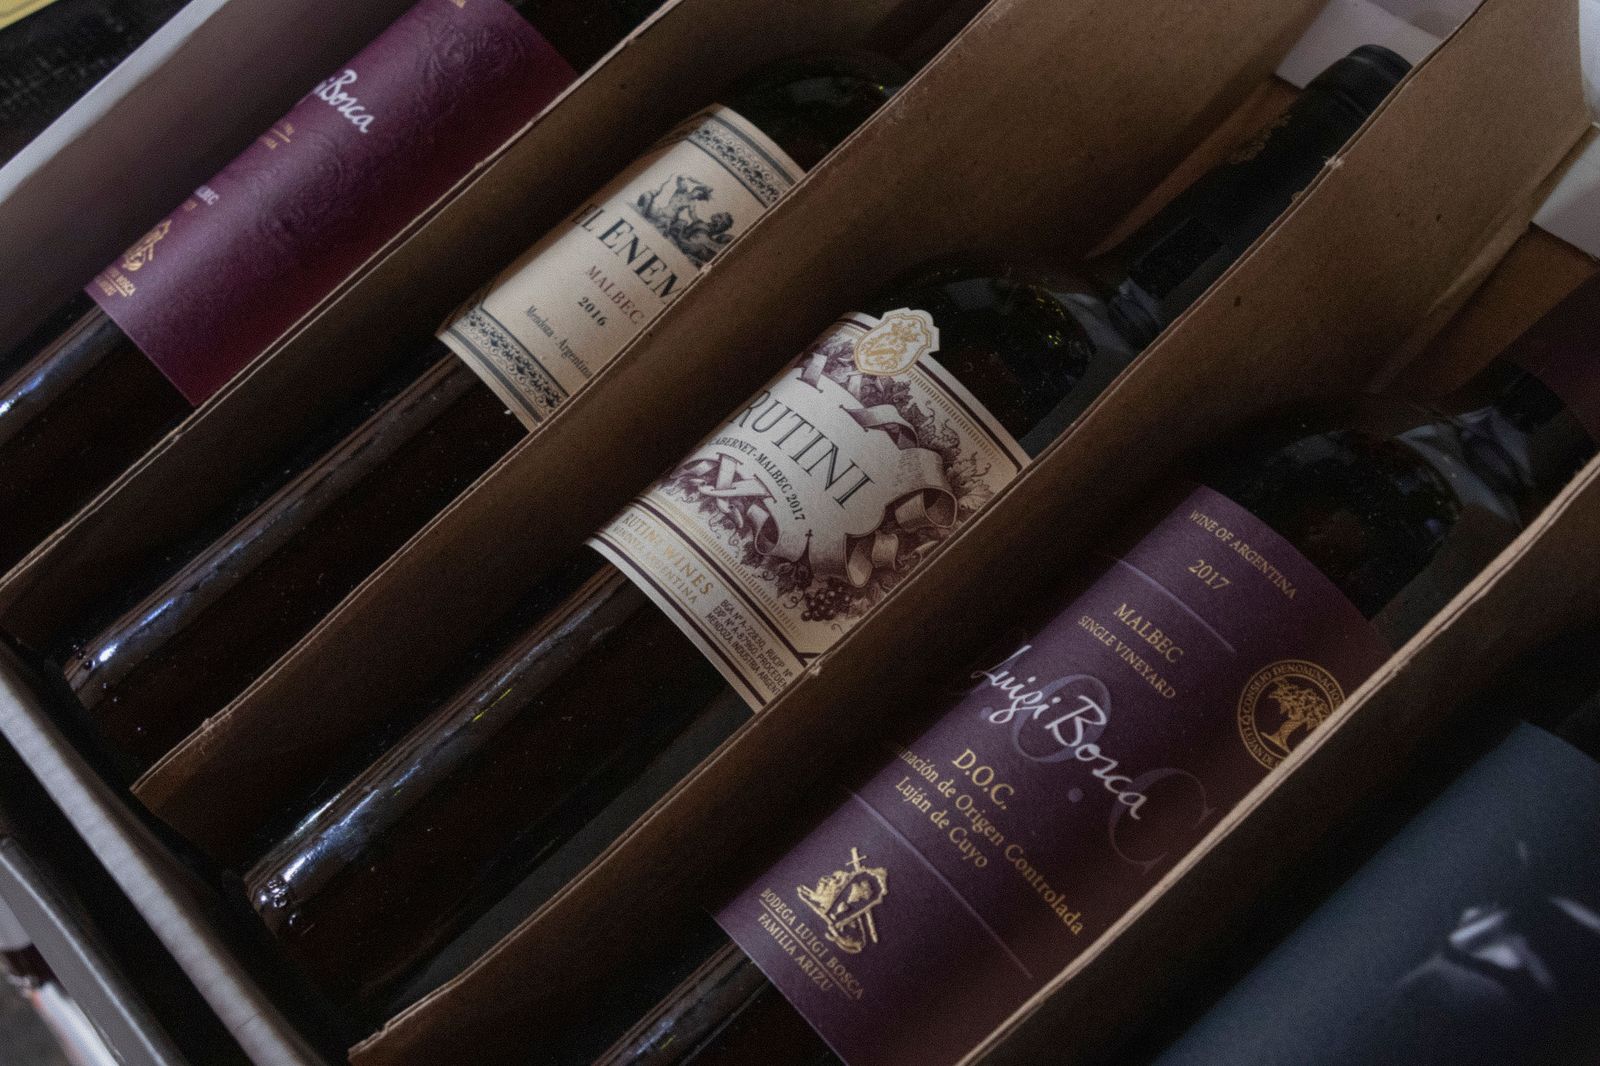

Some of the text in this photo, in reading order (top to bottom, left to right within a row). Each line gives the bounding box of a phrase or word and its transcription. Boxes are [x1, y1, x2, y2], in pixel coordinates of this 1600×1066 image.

[577, 296, 608, 329] 2016
[586, 265, 646, 326] MALBEC
[728, 391, 876, 510] RUTINI
[786, 494, 806, 521] 2017
[664, 544, 713, 595] WINES
[1187, 559, 1232, 590] 2017
[1188, 509, 1297, 601] WINE OF ARGENTINA
[1077, 615, 1176, 699] SINGLE VINEYARD
[1113, 603, 1184, 663] MALBEC
[970, 644, 1148, 820] Luigi Bosca
[952, 748, 1016, 811] D.O.C.
[895, 775, 989, 870] Luján de Cuyo
[936, 779, 958, 798] de
[954, 793, 1005, 846] Origen
[1003, 843, 1084, 936] Controlada
[757, 912, 833, 992] FAMILIA ARIZU
[760, 887, 864, 1000] BODEGA LUIGI BOSCA
